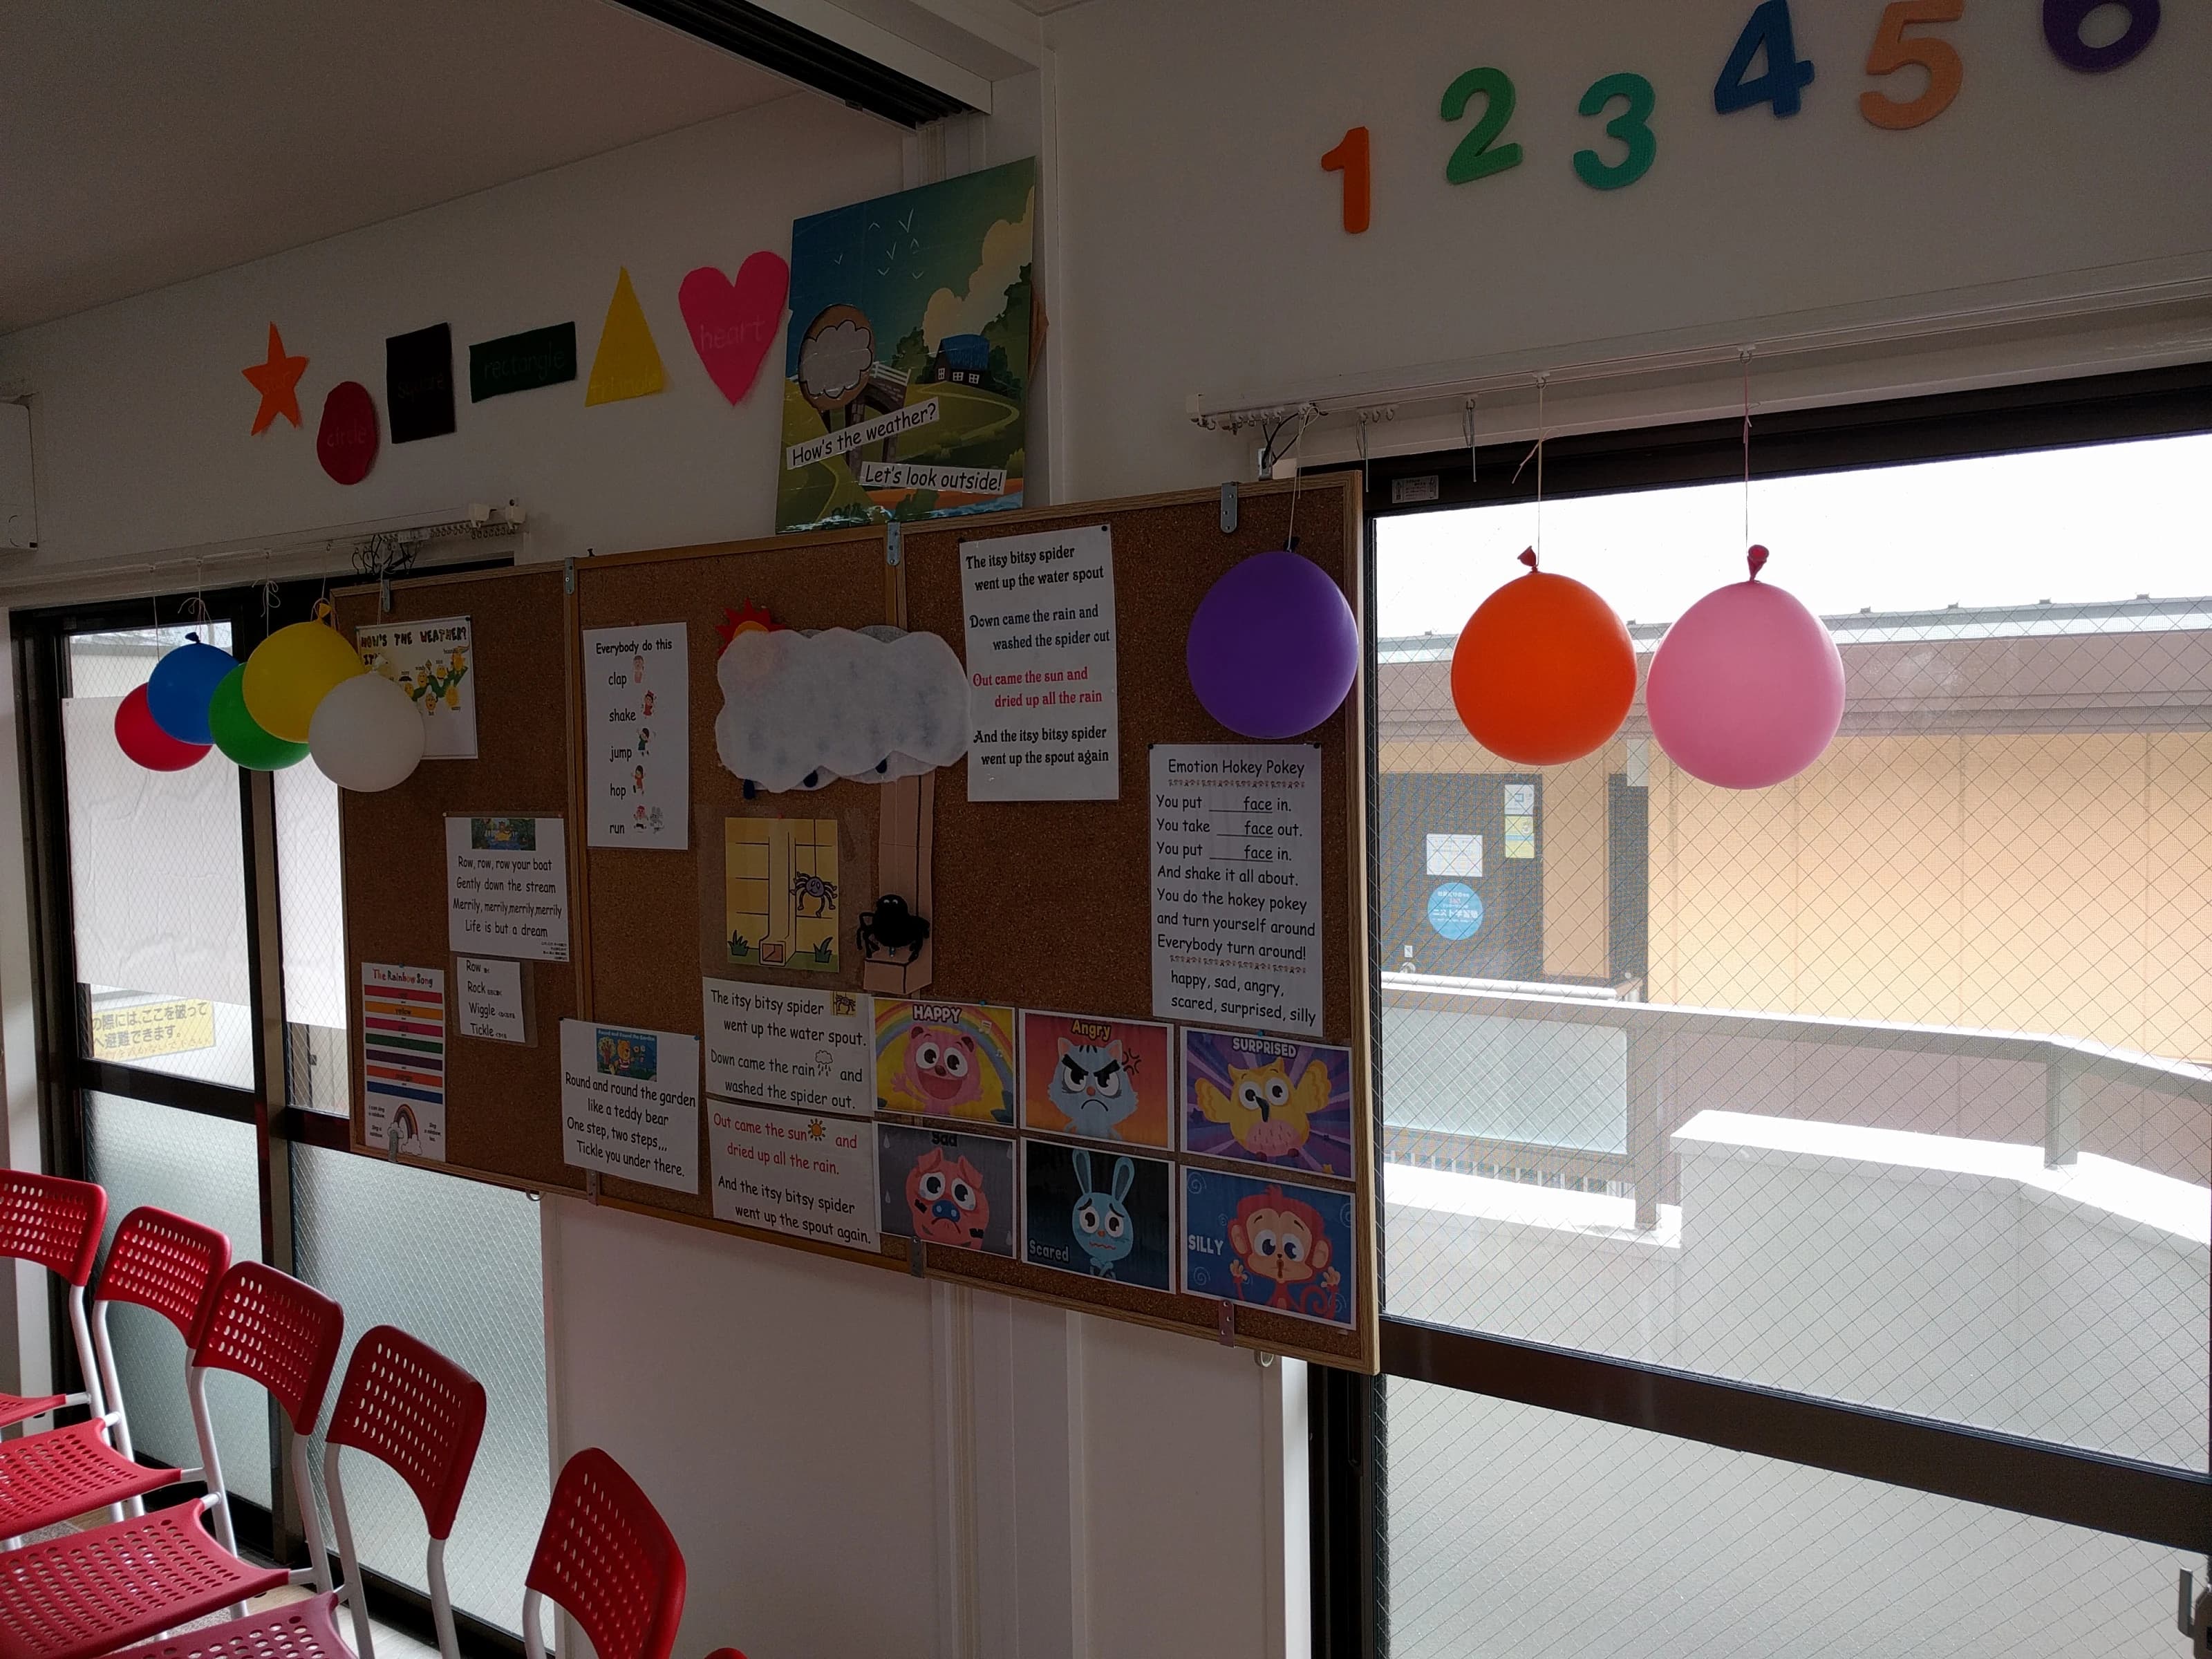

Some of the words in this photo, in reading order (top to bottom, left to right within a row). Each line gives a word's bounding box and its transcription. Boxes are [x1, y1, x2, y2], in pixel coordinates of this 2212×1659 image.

[1321, 126, 1369, 233] 1
[1440, 67, 1523, 185] 2
[1573, 72, 1656, 189] 3
[1713, 0, 1815, 118] 4
[1858, 0, 1964, 130] 5
[700, 320, 765, 351] heart
[483, 346, 565, 383] rectangle
[326, 426, 367, 449] circle
[792, 440, 832, 466] How's
[836, 432, 861, 451] the
[865, 403, 936, 440] weather?
[865, 465, 901, 485] Let's
[906, 467, 937, 487] look
[941, 471, 1002, 492] outside!
[966, 555, 986, 569] The
[988, 554, 1007, 568] itsy
[1010, 551, 1036, 565] bitsy
[1040, 545, 1075, 563] spider
[361, 633, 387, 648] HOW'S
[394, 632, 413, 646] THE
[420, 626, 467, 643] WEATHER?
[596, 640, 639, 656] Everybody
[642, 639, 653, 650] do
[656, 638, 672, 650] this
[993, 635, 1032, 650] washed
[1035, 633, 1052, 647] the
[1055, 630, 1090, 648] spider
[1094, 630, 1110, 642] out
[363, 653, 380, 665] IT'
[608, 672, 627, 688] clap
[973, 673, 993, 686] Out
[995, 675, 1022, 685] came
[1025, 671, 1042, 683] the
[1044, 672, 1063, 682] sun
[1067, 666, 1087, 680] and
[609, 708, 636, 722] shake
[610, 746, 632, 762] jump
[981, 753, 1006, 765] went
[1009, 755, 1022, 767] up
[1025, 751, 1042, 763] the
[1045, 751, 1075, 766] spout
[1078, 749, 1109, 765] again
[1169, 759, 1218, 773] Emotion
[1223, 760, 1262, 778] Hokey
[1267, 760, 1304, 778] Pokey
[610, 783, 626, 800] hop
[1156, 794, 1178, 807] You
[1183, 796, 1202, 812] put
[1244, 797, 1273, 811] face
[1277, 798, 1291, 812] in.
[610, 825, 624, 834] run
[458, 856, 476, 870] Row,
[478, 860, 494, 870] row,
[496, 861, 510, 869] row
[512, 861, 530, 873] your
[533, 857, 552, 871] boat
[457, 877, 480, 892] Gently
[485, 878, 504, 890] down
[507, 879, 522, 892] the
[526, 881, 556, 893] stream
[1158, 865, 1181, 878] And
[1185, 865, 1221, 881] shake
[1226, 868, 1235, 881] it
[1239, 868, 1253, 883] all
[1258, 870, 1298, 886] about.
[453, 898, 482, 914] Merrily,
[465, 919, 481, 932] Life
[485, 921, 491, 932] is
[495, 921, 508, 934] but
[513, 926, 517, 935] a
[521, 924, 547, 937] dream
[467, 959, 481, 972] Row
[373, 968, 386, 980] The
[388, 971, 415, 984] Rainbow
[417, 973, 433, 988] Song
[468, 981, 486, 993] Rock
[469, 1002, 496, 1018] Wiggle
[711, 990, 729, 1004] The
[732, 993, 751, 1011] itsy
[755, 995, 783, 1015] bitsy
[787, 1000, 824, 1017] spider
[912, 1004, 961, 1023] HAPPY
[1171, 997, 1217, 1013] scared,
[1221, 1002, 1286, 1021] surprised,
[1290, 1008, 1315, 1027] silly
[470, 1023, 494, 1037] Tickle
[1072, 1019, 1112, 1041] Angry
[1232, 1036, 1297, 1059] SURPRISED
[711, 1049, 735, 1066] Down
[738, 1058, 765, 1070] came
[769, 1058, 789, 1074] the
[792, 1063, 815, 1077] rain
[841, 1068, 862, 1082] and
[565, 1071, 590, 1089] Round
[593, 1080, 608, 1092] and
[611, 1084, 638, 1098] round
[640, 1086, 657, 1100] the
[659, 1091, 695, 1107] garden
[588, 1098, 603, 1114] like
[606, 1106, 612, 1116] a
[614, 1105, 642, 1125] teddy
[646, 1109, 668, 1125] bear
[567, 1116, 584, 1132] One
[587, 1123, 609, 1140] step,
[611, 1127, 628, 1141] two
[631, 1132, 667, 1152] steps...
[932, 1132, 957, 1147] Sad
[577, 1140, 603, 1158] Tickle
[606, 1150, 620, 1163] you
[624, 1153, 650, 1169] under
[654, 1157, 684, 1177] there.
[727, 1142, 754, 1159] dried
[758, 1151, 769, 1165] up
[774, 1151, 785, 1165] all
[789, 1154, 809, 1169] the
[814, 1159, 838, 1174] rain.
[735, 1206, 760, 1220] went
[764, 1212, 776, 1226] up
[780, 1213, 799, 1228] the
[803, 1221, 834, 1235] spout
[837, 1228, 870, 1244] again.
[1028, 1239, 1070, 1263] Scared
[1188, 1234, 1224, 1256] SILLY
